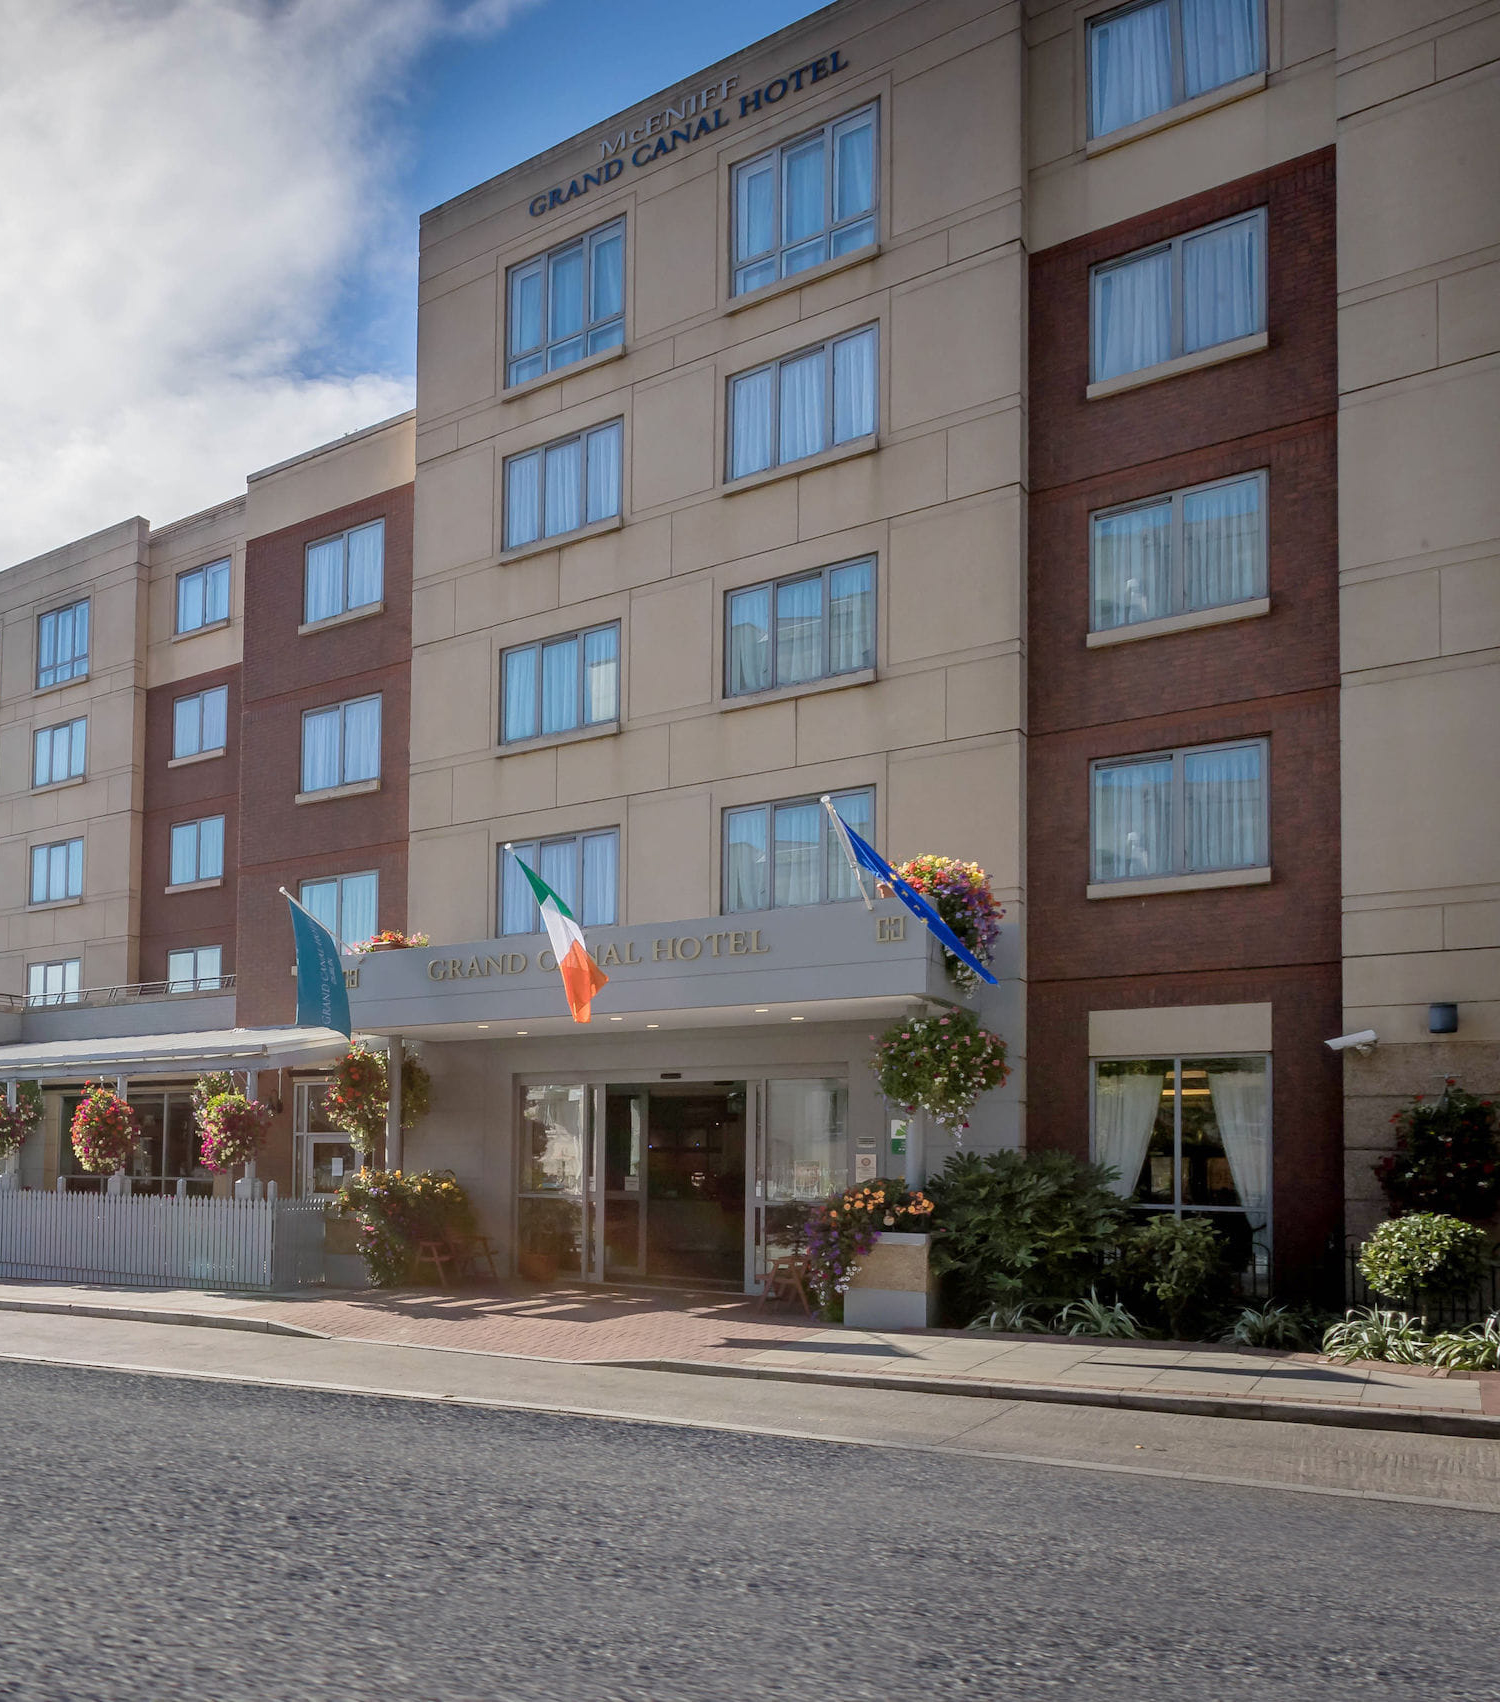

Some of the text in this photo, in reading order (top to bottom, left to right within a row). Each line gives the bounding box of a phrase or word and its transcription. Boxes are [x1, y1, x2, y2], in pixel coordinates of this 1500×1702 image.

[529, 50, 849, 217] GRAND CANAL HOTEL
[600, 74, 740, 161] McENIFF
[427, 929, 771, 981] GRAND CNAL HOTEL
